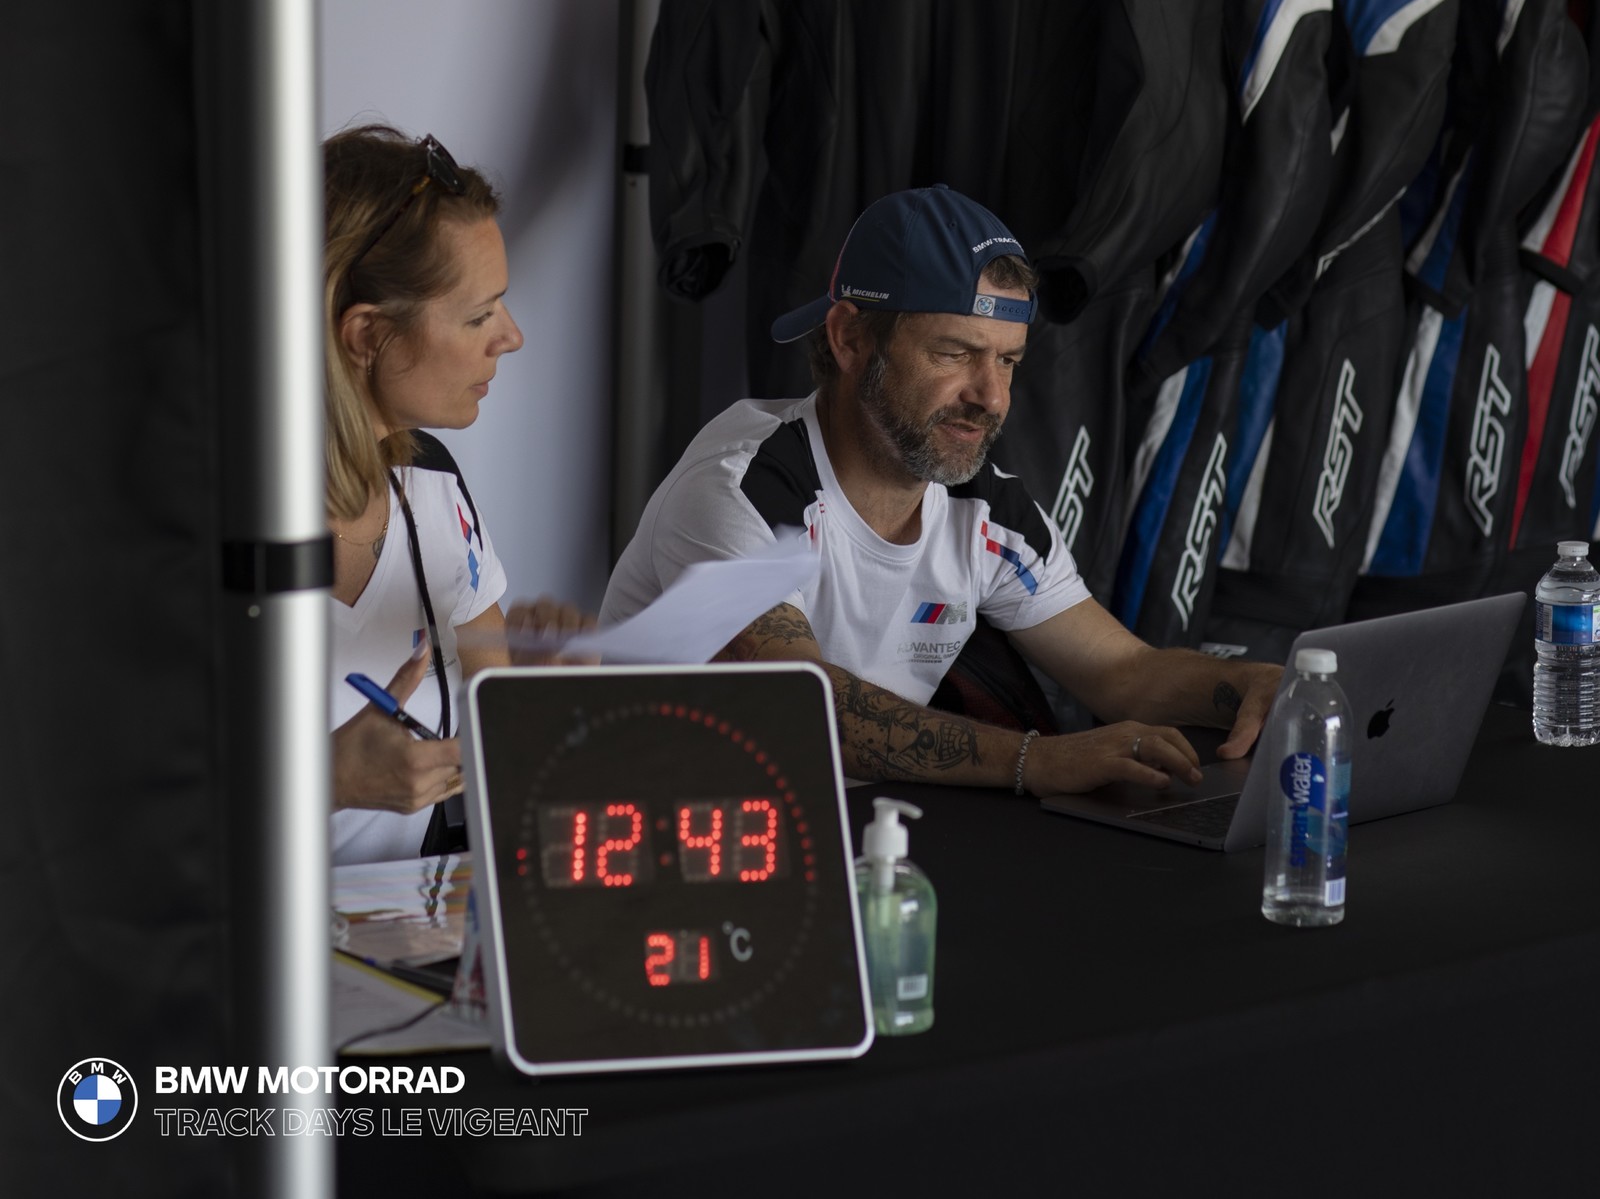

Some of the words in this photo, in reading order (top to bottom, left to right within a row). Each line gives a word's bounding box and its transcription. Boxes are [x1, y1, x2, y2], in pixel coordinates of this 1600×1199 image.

[852, 288, 890, 299] MICHELIN
[972, 238, 993, 253] BMW
[1312, 358, 1363, 549] RST
[1463, 343, 1512, 537] RST
[1171, 432, 1227, 632] RST
[645, 933, 710, 986] 21
